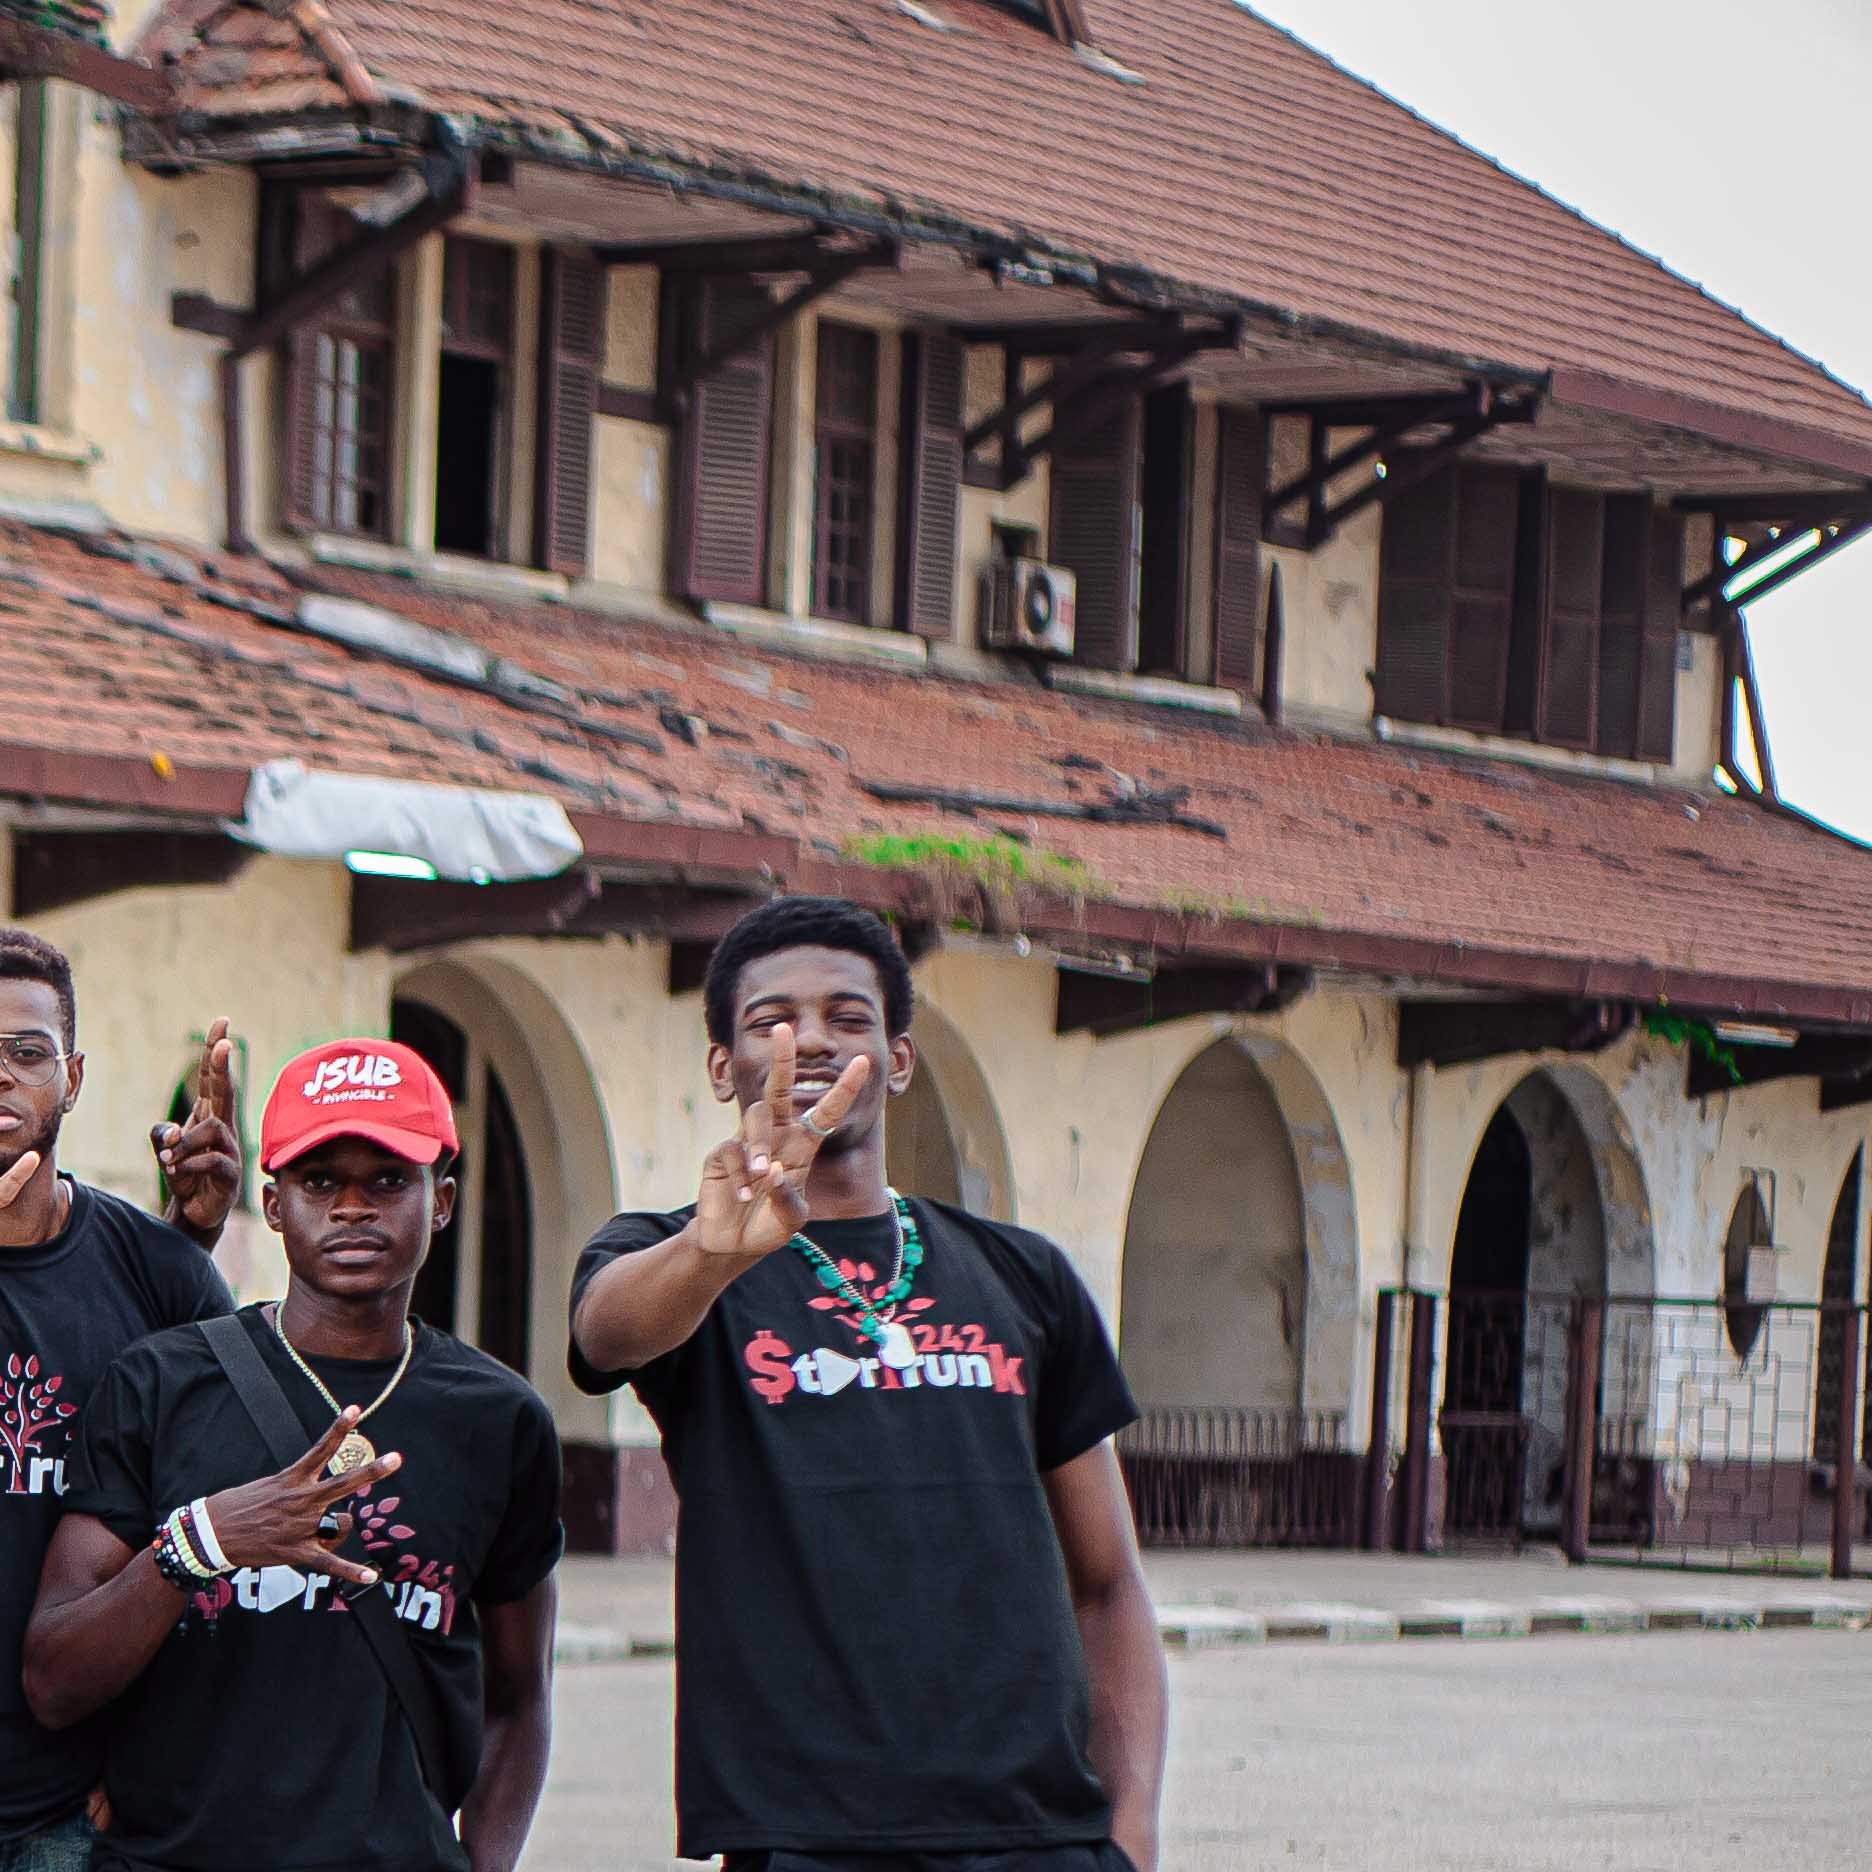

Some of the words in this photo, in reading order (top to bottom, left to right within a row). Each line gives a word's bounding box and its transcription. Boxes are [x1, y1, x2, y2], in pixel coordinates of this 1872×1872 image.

[303, 1054, 402, 1097] JSUB
[911, 1323, 989, 1354] 242
[393, 1554, 454, 1588] 24
